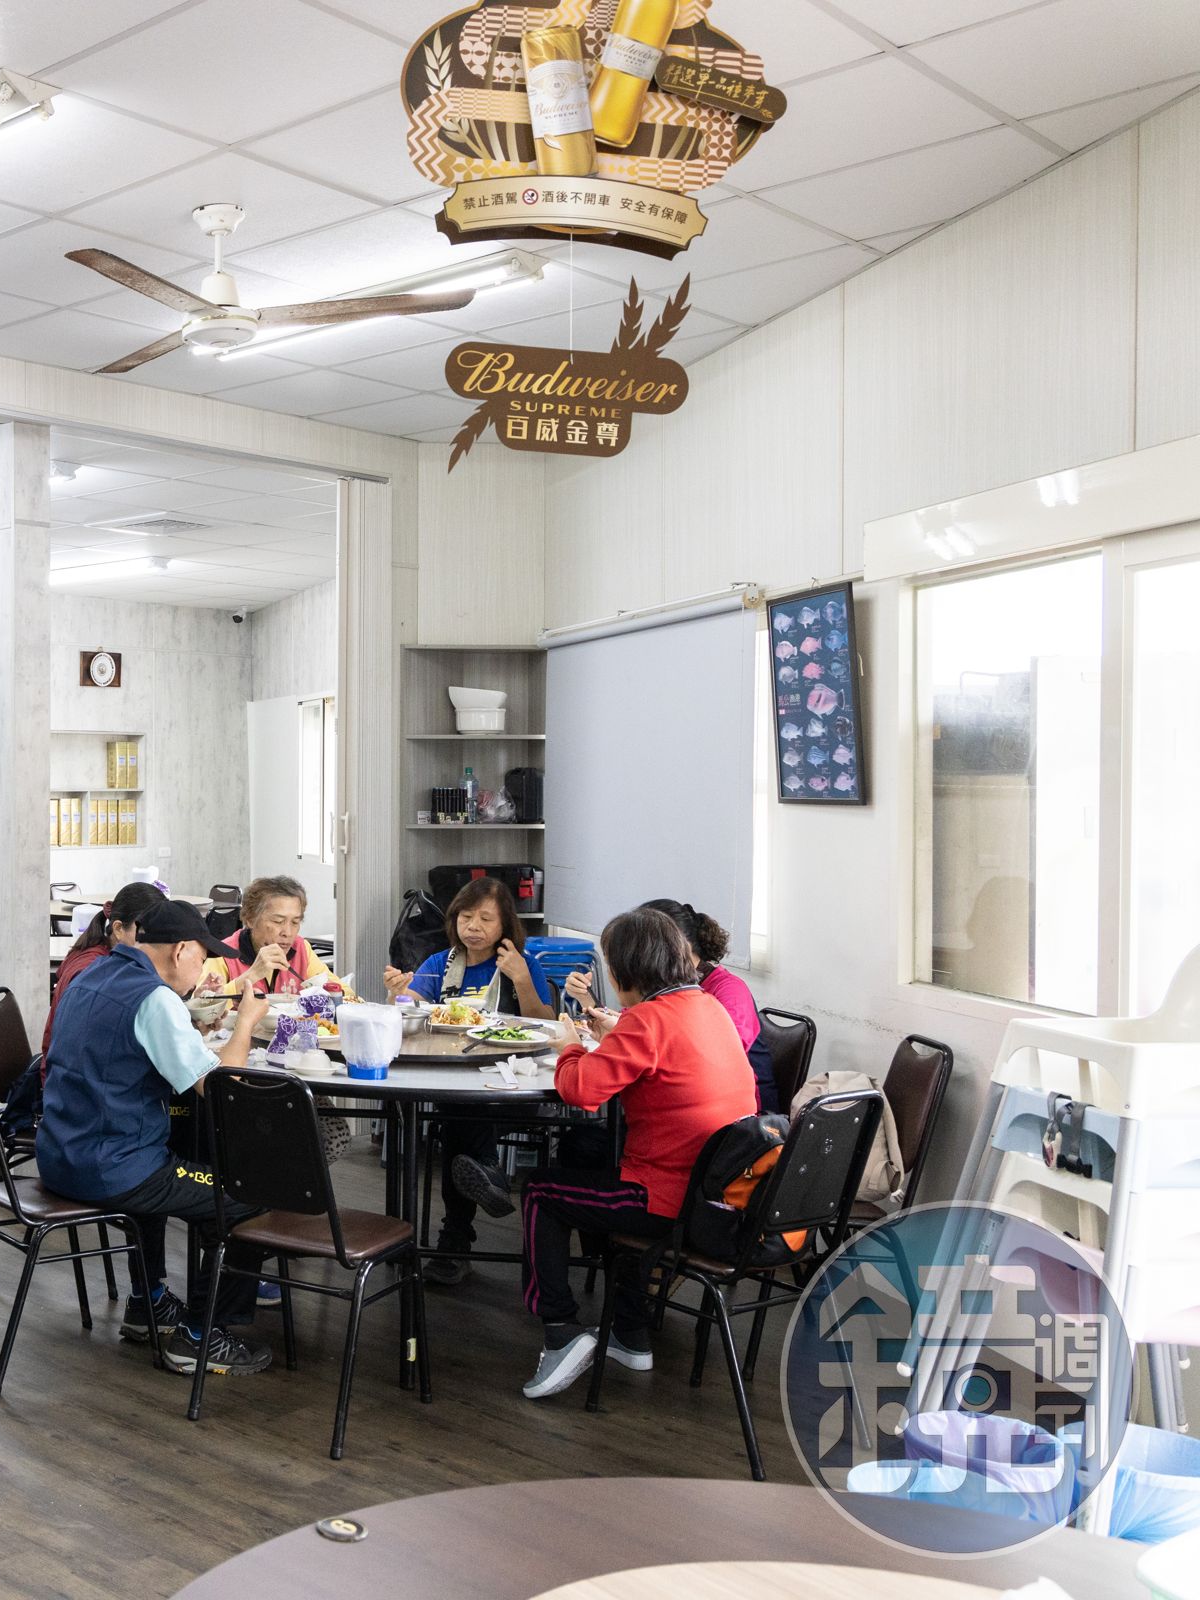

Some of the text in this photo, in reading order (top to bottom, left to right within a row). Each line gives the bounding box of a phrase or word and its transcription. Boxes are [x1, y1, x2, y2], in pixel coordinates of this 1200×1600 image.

[462, 190, 688, 225] 禁止酒駕 酒後不開車 安全有保障
[457, 350, 679, 404] Budweiser
[509, 400, 623, 419] SUPREME
[506, 414, 620, 447] 百威金尊
